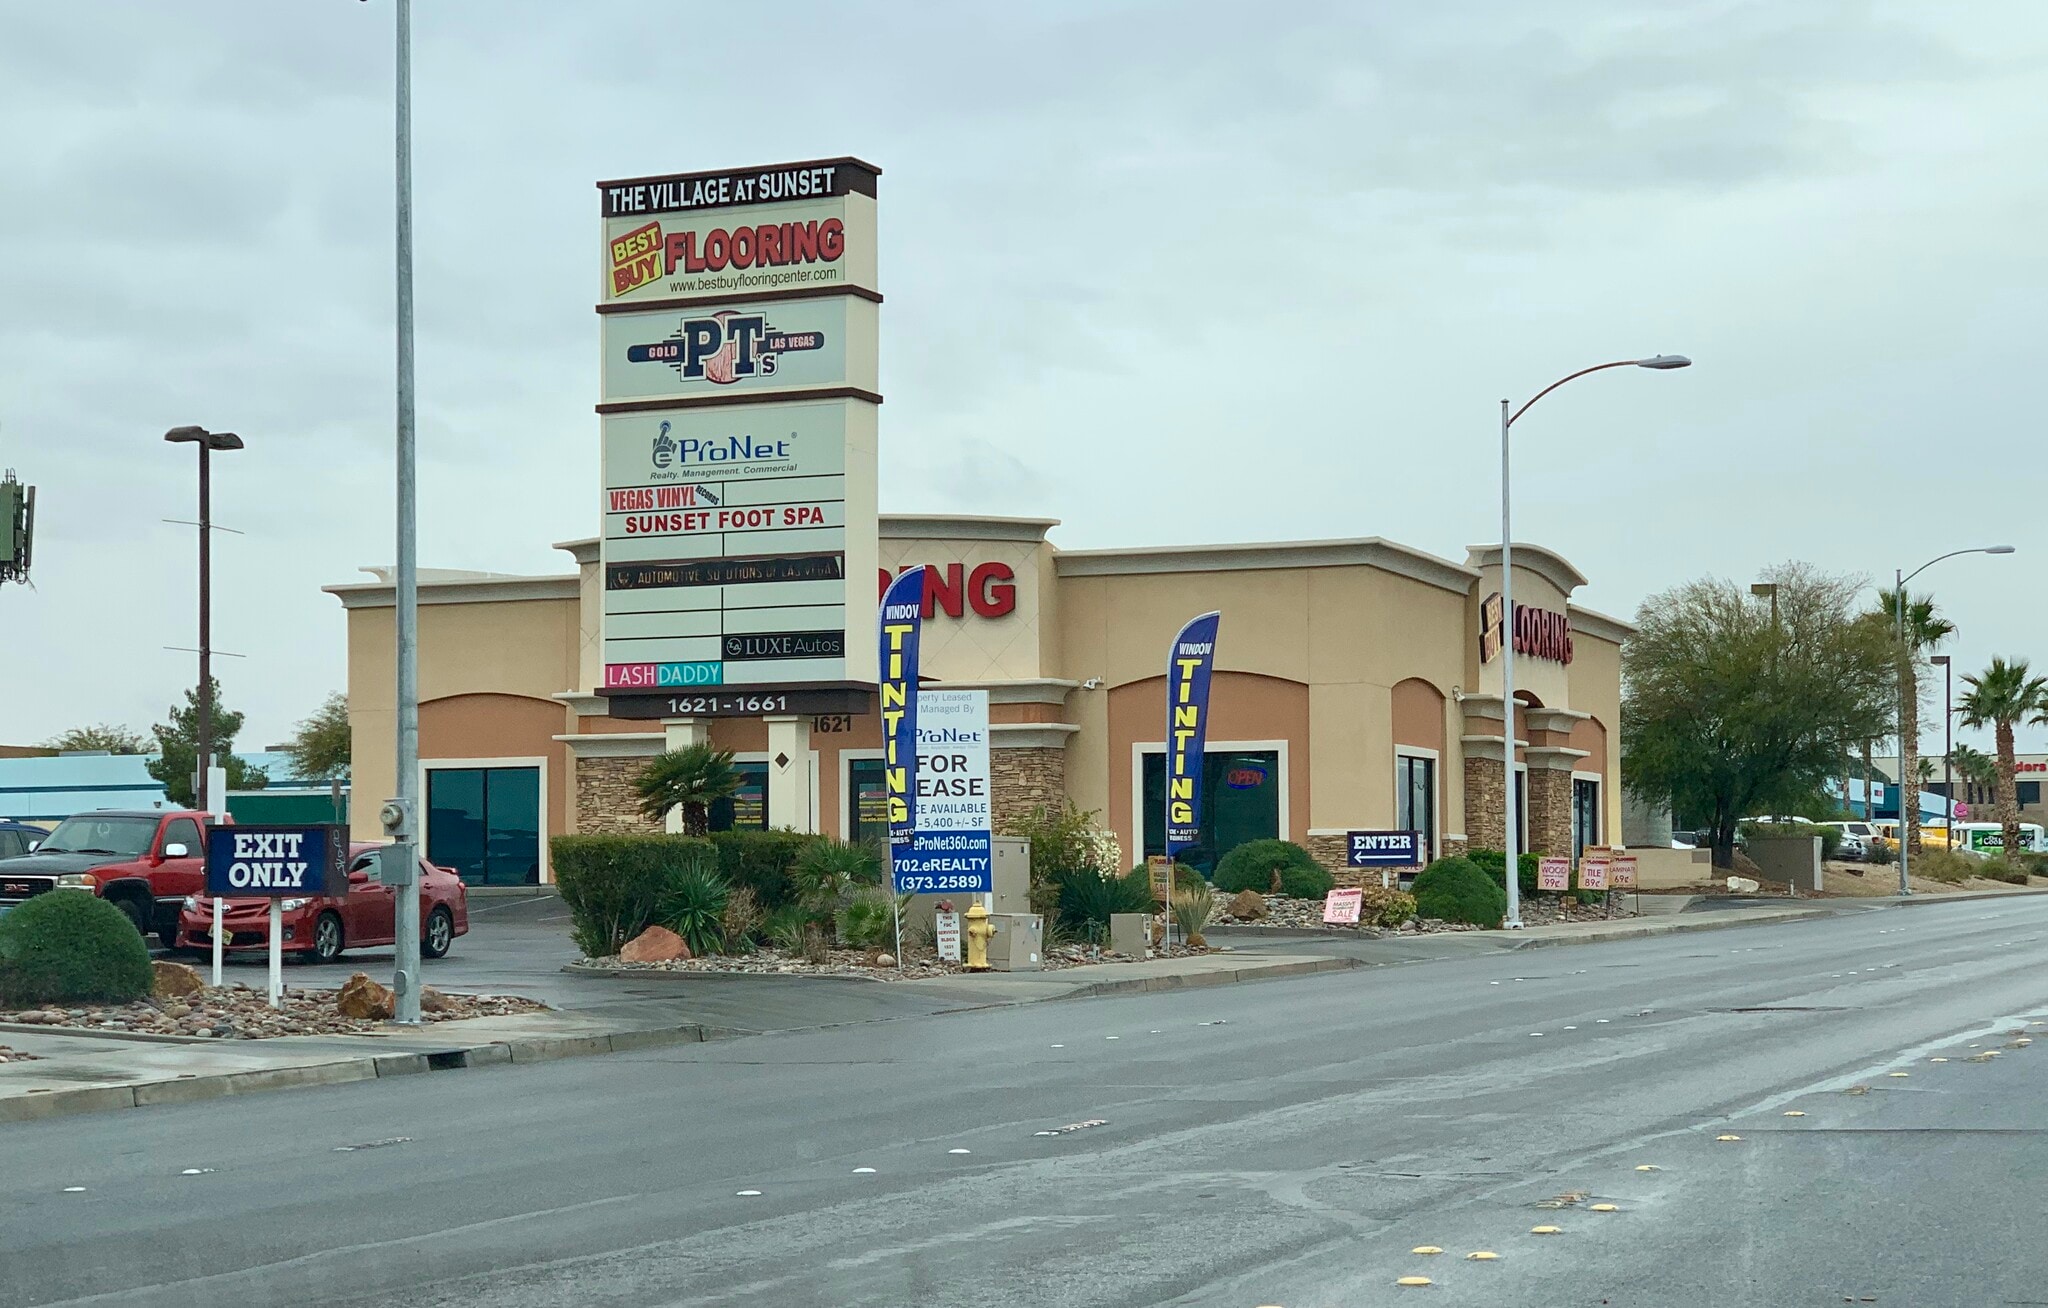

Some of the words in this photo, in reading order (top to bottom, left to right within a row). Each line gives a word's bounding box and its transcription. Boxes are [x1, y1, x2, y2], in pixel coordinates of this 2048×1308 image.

[609, 186, 646, 213] THE
[650, 178, 730, 209] VILLAGE
[734, 179, 756, 201] AT
[759, 167, 836, 197] SUNSET
[614, 226, 659, 262] BEST
[665, 218, 844, 275] FLOORING
[613, 254, 659, 293] BUY
[669, 267, 837, 293] www.bestbuyflooringcenter.com
[648, 345, 678, 358] GOLD
[769, 336, 786, 349] LAS
[788, 335, 815, 348] VEGAS
[650, 471, 679, 480] Realty.
[682, 467, 741, 479] Management.
[743, 463, 798, 475] Commercial
[609, 488, 654, 511] VEGAS
[656, 485, 697, 509] VINYL
[695, 484, 720, 506] RECORDS
[626, 512, 711, 534] SUNSET
[719, 508, 776, 529] FOOT
[783, 506, 824, 526] SPA
[707, 566, 763, 582] SOUTIONS
[1512, 600, 1574, 665] LOORING
[746, 637, 792, 655] LUXE
[793, 638, 840, 653] Autos
[609, 665, 655, 685] LASH
[658, 664, 720, 684] DADDY
[942, 693, 972, 702] Leased
[920, 704, 960, 714] Managed
[963, 704, 974, 714] By
[813, 716, 852, 733] 1621
[883, 624, 913, 823] TINTING
[1170, 659, 1203, 824] TINTING
[916, 755, 968, 773] FOR
[1228, 769, 1263, 785] OPEN
[917, 778, 984, 797] EASE
[930, 803, 987, 814] AVAILABLE
[924, 817, 953, 829] 5,400
[972, 817, 984, 827] SF
[233, 834, 303, 858] EXIT
[1353, 835, 1411, 849] ENTER
[894, 858, 988, 872] 702.eREALTY
[1542, 866, 1566, 874] WOOD
[1587, 868, 1601, 878] TILE
[228, 862, 308, 888] ONLY
[900, 875, 982, 890] (373.2589)
[1544, 878, 1561, 888] 99¢
[1584, 878, 1601, 888] 89¢
[1332, 910, 1354, 918] SALE
